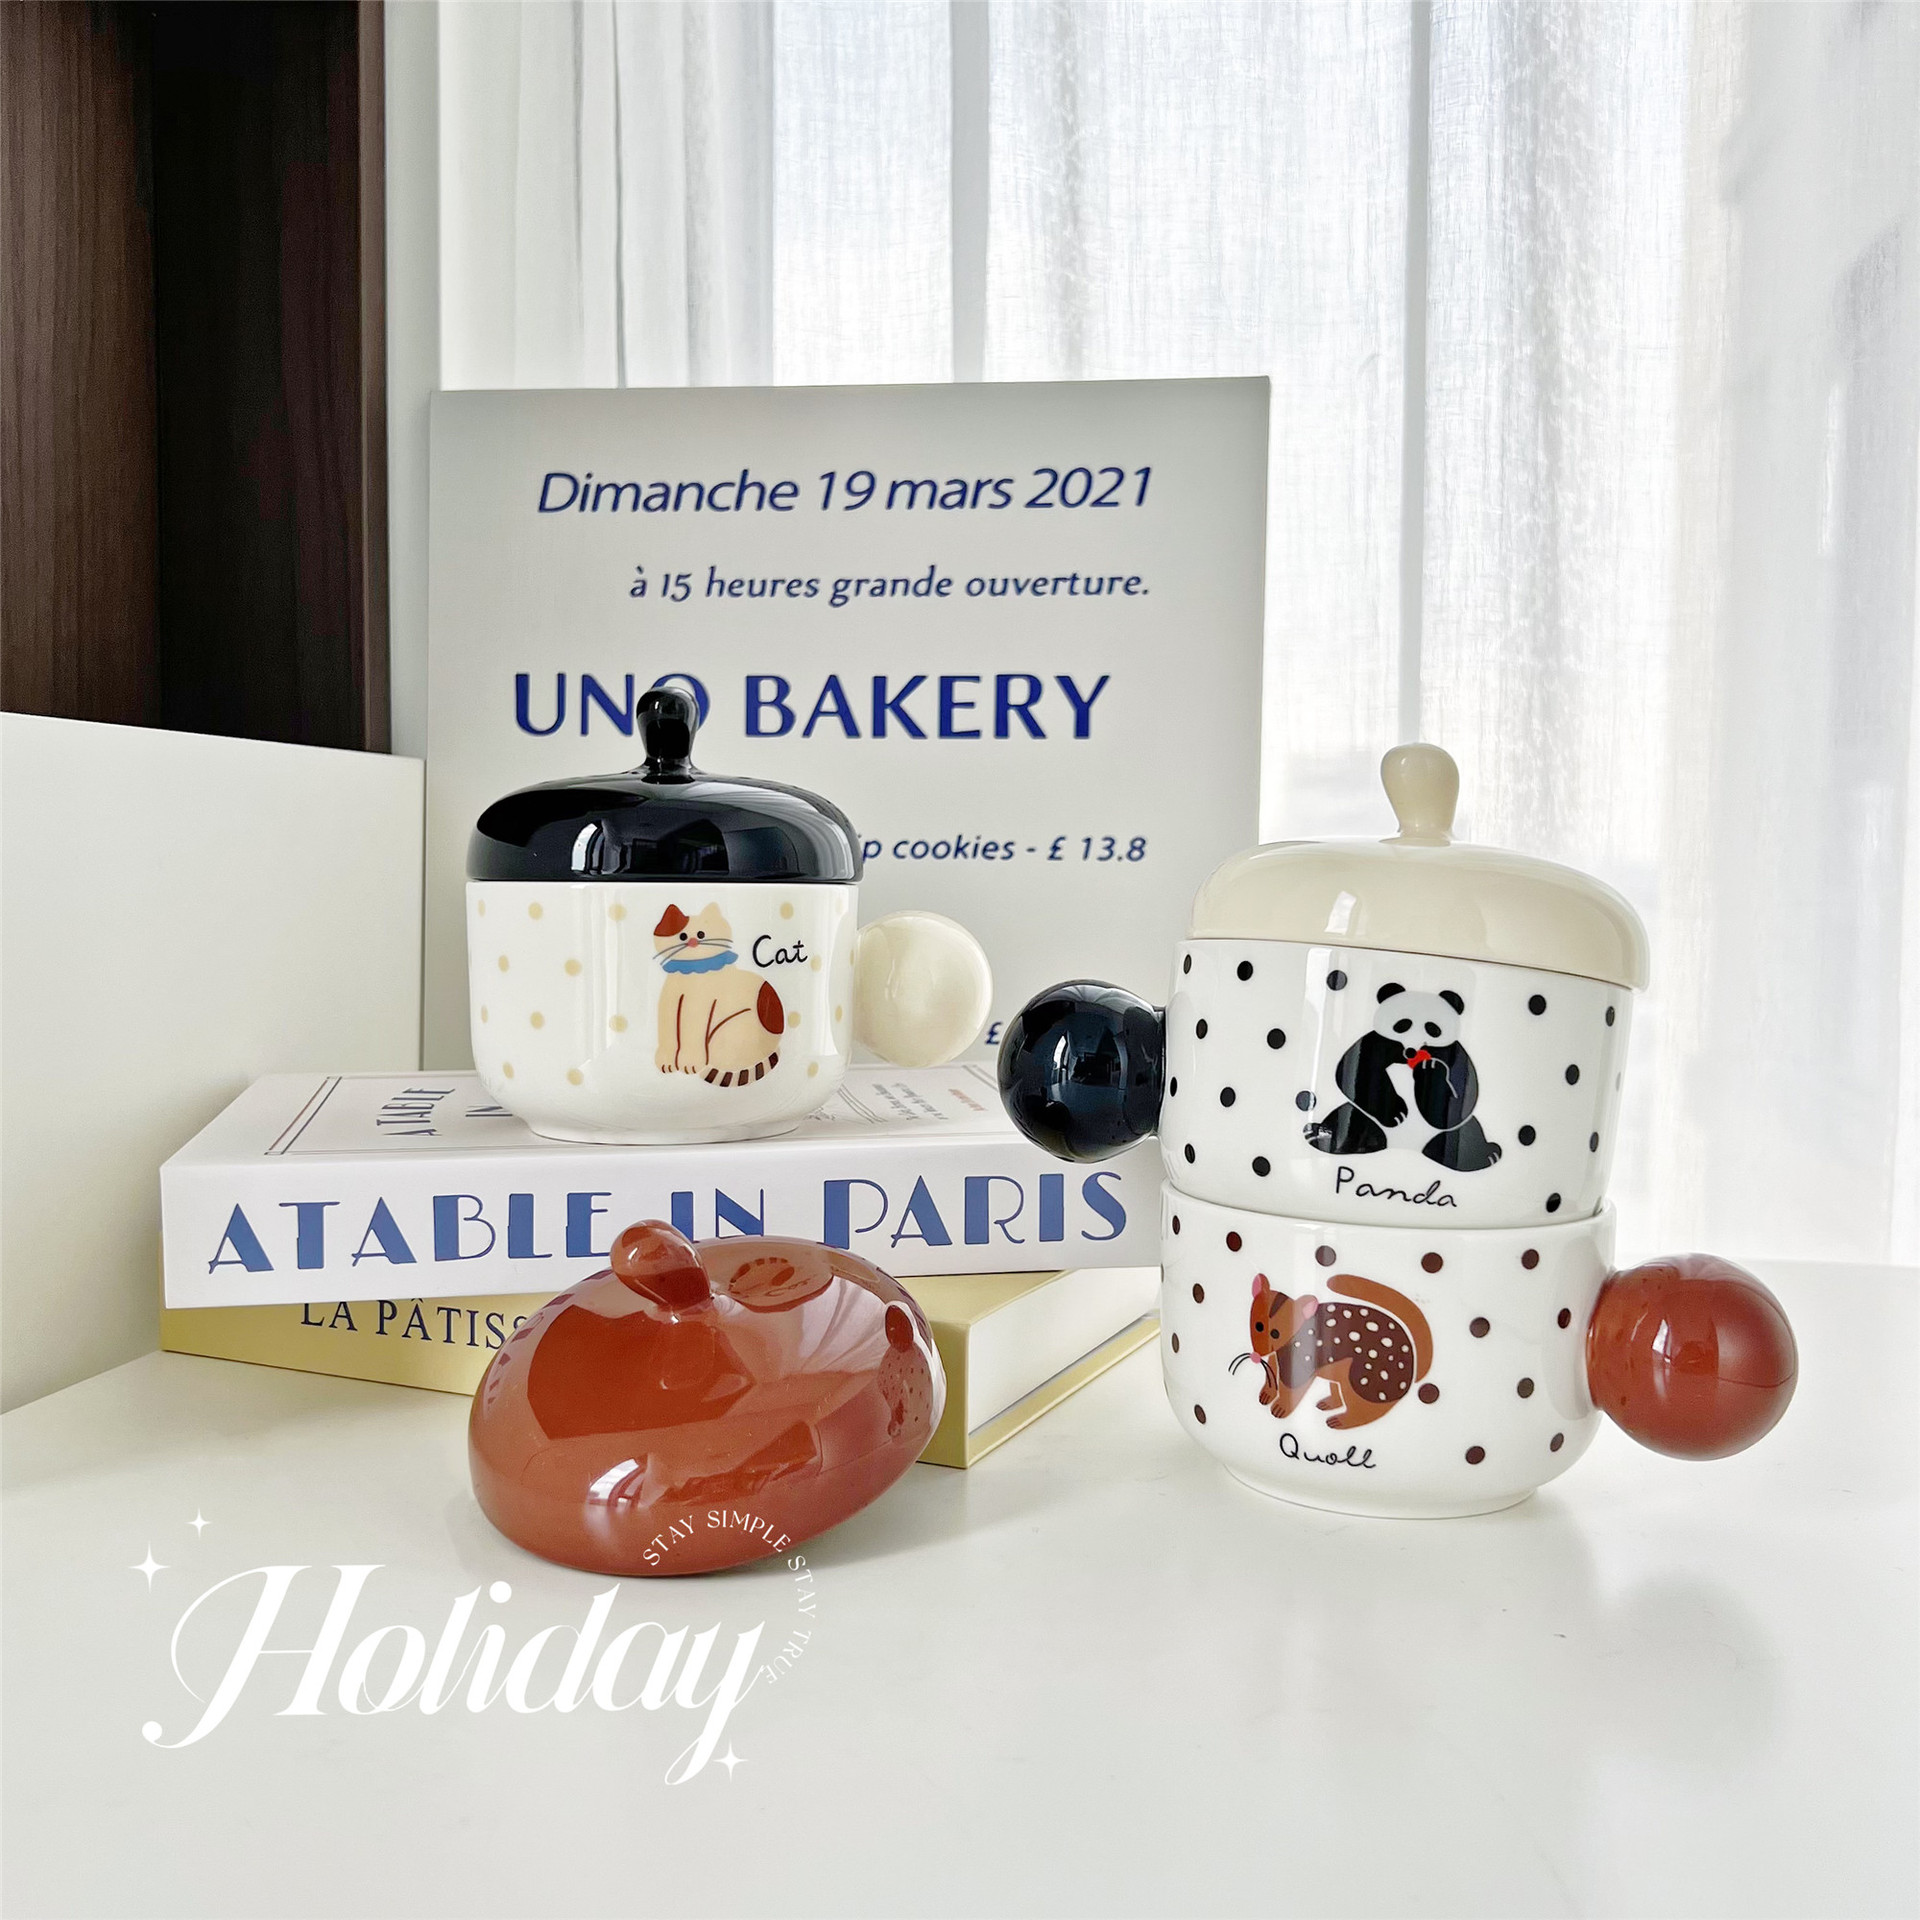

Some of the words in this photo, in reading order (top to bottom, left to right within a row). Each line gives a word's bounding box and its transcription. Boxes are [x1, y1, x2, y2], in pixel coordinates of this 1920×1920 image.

[537, 468, 800, 514] Dimanche
[818, 470, 877, 512] 19
[885, 477, 1015, 511] mars
[1024, 466, 1152, 509] 2021
[629, 565, 648, 599] à
[660, 572, 693, 603] 15
[705, 565, 821, 600] heures
[828, 564, 954, 609] grande
[965, 572, 1150, 600] ouverture.
[744, 672, 1112, 740] BAKERY
[892, 834, 1016, 861] cookies
[1046, 835, 1068, 862] £
[1081, 836, 1148, 862] 13.8
[752, 934, 808, 968] Cat
[1335, 1165, 1458, 1208] Panda
[207, 1191, 614, 1275] ATABLE
[670, 1187, 765, 1243] IN
[823, 1171, 1128, 1251] PARIS
[301, 1301, 358, 1331] LA
[1279, 1432, 1377, 1469] Quoll
